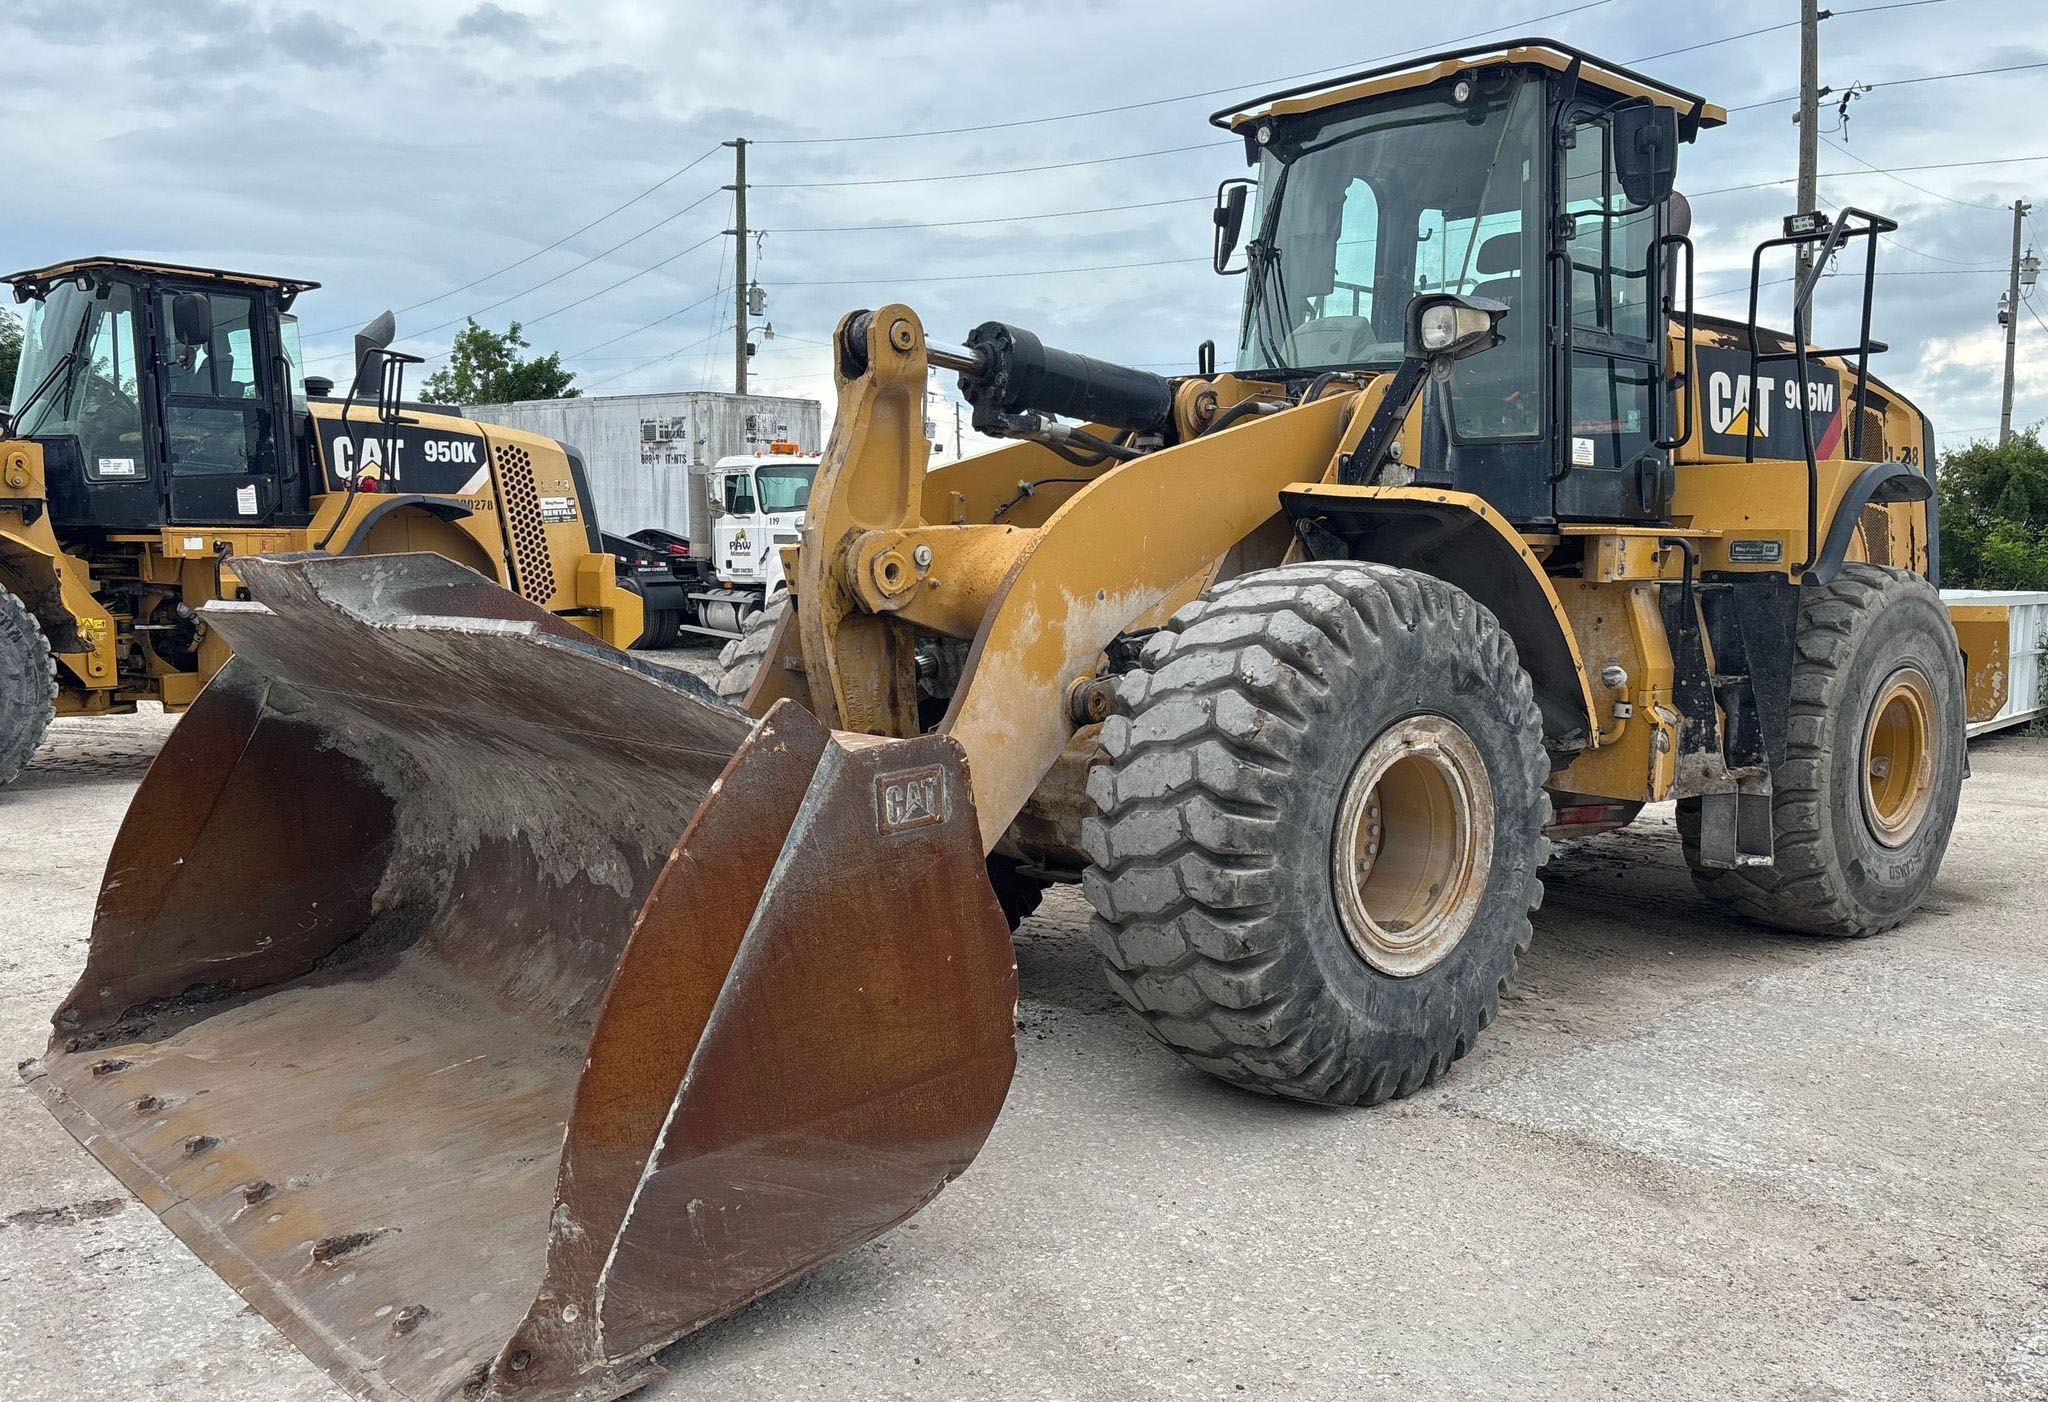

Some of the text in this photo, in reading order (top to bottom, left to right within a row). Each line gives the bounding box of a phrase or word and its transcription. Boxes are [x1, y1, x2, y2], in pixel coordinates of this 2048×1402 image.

[1710, 371, 1774, 437] CAT
[333, 436, 477, 481] CAT 950K
[769, 517, 780, 526] 119
[729, 541, 751, 551] PAW
[886, 778, 938, 825] CAT
[1889, 858, 1915, 880] CAMSO
